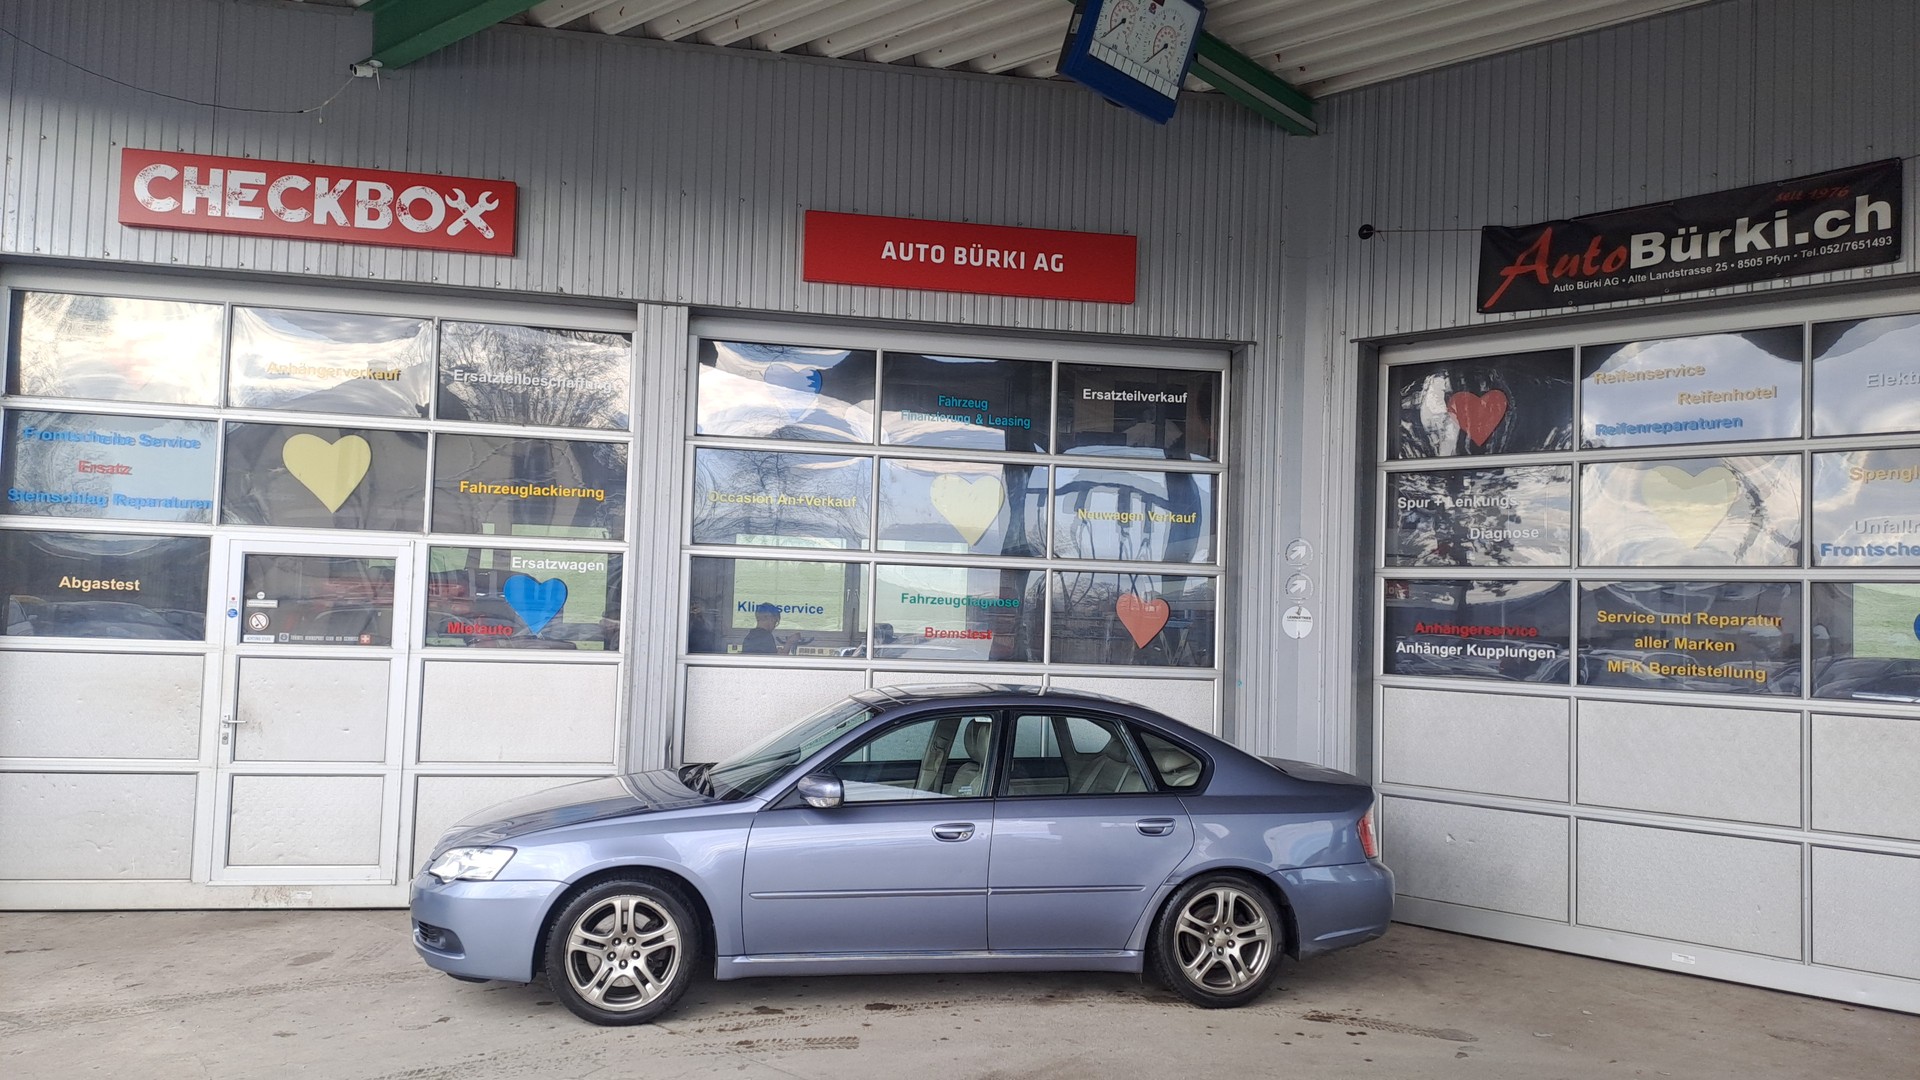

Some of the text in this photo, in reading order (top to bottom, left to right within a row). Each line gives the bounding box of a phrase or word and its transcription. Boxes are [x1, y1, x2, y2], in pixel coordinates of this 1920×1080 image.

[134, 164, 499, 240] CHECKBOX
[881, 241, 1064, 272] AUTO BÜRKI AG
[1553, 282, 1575, 293] Auto
[1576, 278, 1602, 290] Bürki
[1604, 277, 1619, 287] AG
[1628, 273, 1647, 284] Alte
[1650, 265, 1712, 281] Landstrasse
[1715, 261, 1728, 272] 25
[1737, 257, 1763, 269] 8505
[1766, 254, 1791, 265] Pfyn
[265, 361, 402, 382] Anhängerverkauf
[1594, 363, 1706, 385] Reifenservice
[453, 369, 613, 394] Ersatzteilbeschaffung
[938, 395, 988, 411] Fahrzeug
[1083, 388, 1187, 404] Ersatzteilverkauf
[1678, 385, 1778, 405] Reifenhotel
[901, 410, 1031, 429] Finanzierung & Leasing
[1595, 416, 1744, 436] Reifenreparaturen
[23, 426, 201, 449] Frontscheibe Service
[77, 460, 133, 475] Ersatz
[460, 480, 605, 500] Fahrzeuglackierung
[8, 488, 213, 511] Steinschlag Reparaturen
[708, 491, 857, 508] Occasion An+Verkauf
[1397, 497, 1431, 511] Spur
[1450, 495, 1519, 509] Lenkungs
[1078, 508, 1197, 524] Neuwagen Verkauf
[1470, 527, 1539, 541] Diagnose
[1820, 542, 1920, 557] Frontsche
[512, 557, 604, 573] Ersatzwagen
[59, 576, 140, 592] Abgastest
[738, 601, 824, 615] Kliservice
[901, 593, 1020, 609] Fahrzeugdiagnose
[1597, 610, 1782, 628] Service und Reparatur
[448, 622, 513, 636] Mietauto
[924, 627, 993, 640] Bremstest
[1415, 622, 1537, 637] Anhängerservice
[1396, 641, 1556, 661] Anhänger Kupplungen
[1635, 636, 1735, 651] aller Marken
[1608, 660, 1767, 683] MFK Bereitstellung
